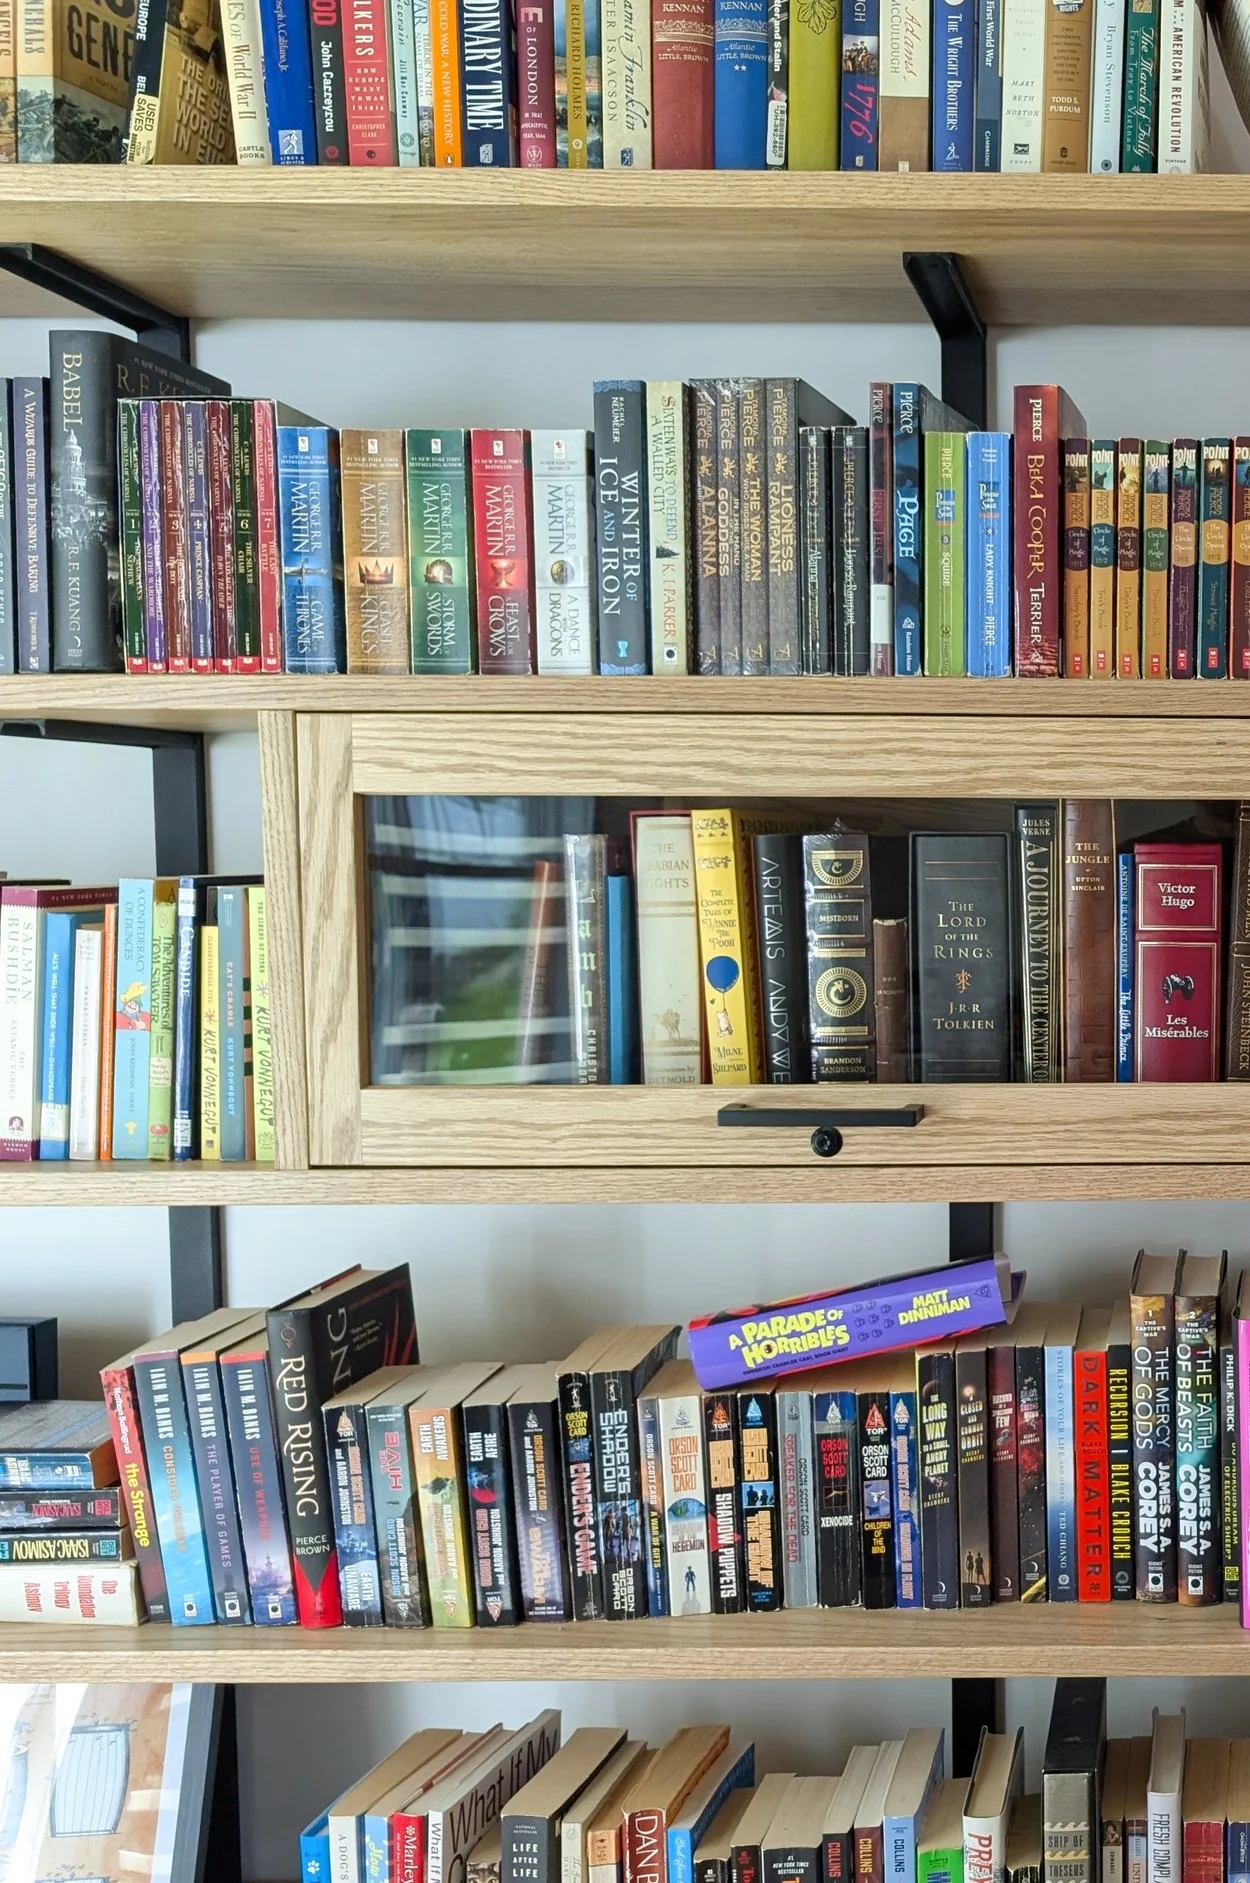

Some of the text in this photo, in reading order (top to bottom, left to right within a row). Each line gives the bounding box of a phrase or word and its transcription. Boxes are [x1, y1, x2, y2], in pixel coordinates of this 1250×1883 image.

[662, 2, 704, 14] KENNAN
[321, 41, 333, 67] John
[570, 3, 584, 121] RICHARD HOLMES
[527, 38, 538, 106] LONDON
[945, 14, 962, 131] THE WRIGHT BROTHERS
[1170, 26, 1182, 153] AMERICAN REVOLUTION
[134, 98, 146, 131] SAVES
[144, 103, 156, 131] USED
[844, 81, 876, 144] 1776
[62, 352, 82, 431] BABEL
[1029, 398, 1042, 442] PIERCE
[423, 483, 441, 554] MARTIN
[1028, 454, 1045, 579] BEKA COOPER
[600, 456, 621, 616] ICE AND IRON
[620, 471, 641, 601] WINTER OF
[69, 546, 81, 631] R. F. KUANG
[426, 592, 442, 654] SWORDS
[1030, 583, 1044, 644] TERRIER
[1022, 828, 1050, 836] VERNE
[1023, 819, 1050, 827] JULES
[1065, 855, 1110, 864] JUNGLE
[1158, 882, 1196, 895] Victor
[1161, 895, 1195, 907] Hugo
[819, 914, 859, 922] MISTBORN
[949, 901, 974, 912] THE
[937, 914, 986, 928] LORD
[945, 932, 958, 941] OF
[934, 945, 993, 959] RINGS
[1026, 841, 1049, 1065] A JOURNEY TO THE CENTER
[933, 1018, 995, 1030] TOLKIEN
[1145, 1026, 1209, 1039] Misérables
[1166, 1014, 1187, 1025] Les
[897, 1296, 971, 1326] DINNIMAN
[912, 1288, 948, 1307] MATT
[728, 1309, 844, 1350] A PARADE OF
[742, 1325, 850, 1369] HORRIBLES
[276, 1355, 319, 1517] RED RISING
[821, 1515, 853, 1528] XENOCIDE
[512, 1843, 538, 1852] LIFE
[1048, 1836, 1084, 1849] SHIP OF
[512, 1868, 538, 1878] LIFE
[1049, 1864, 1084, 1876] THESEUS
